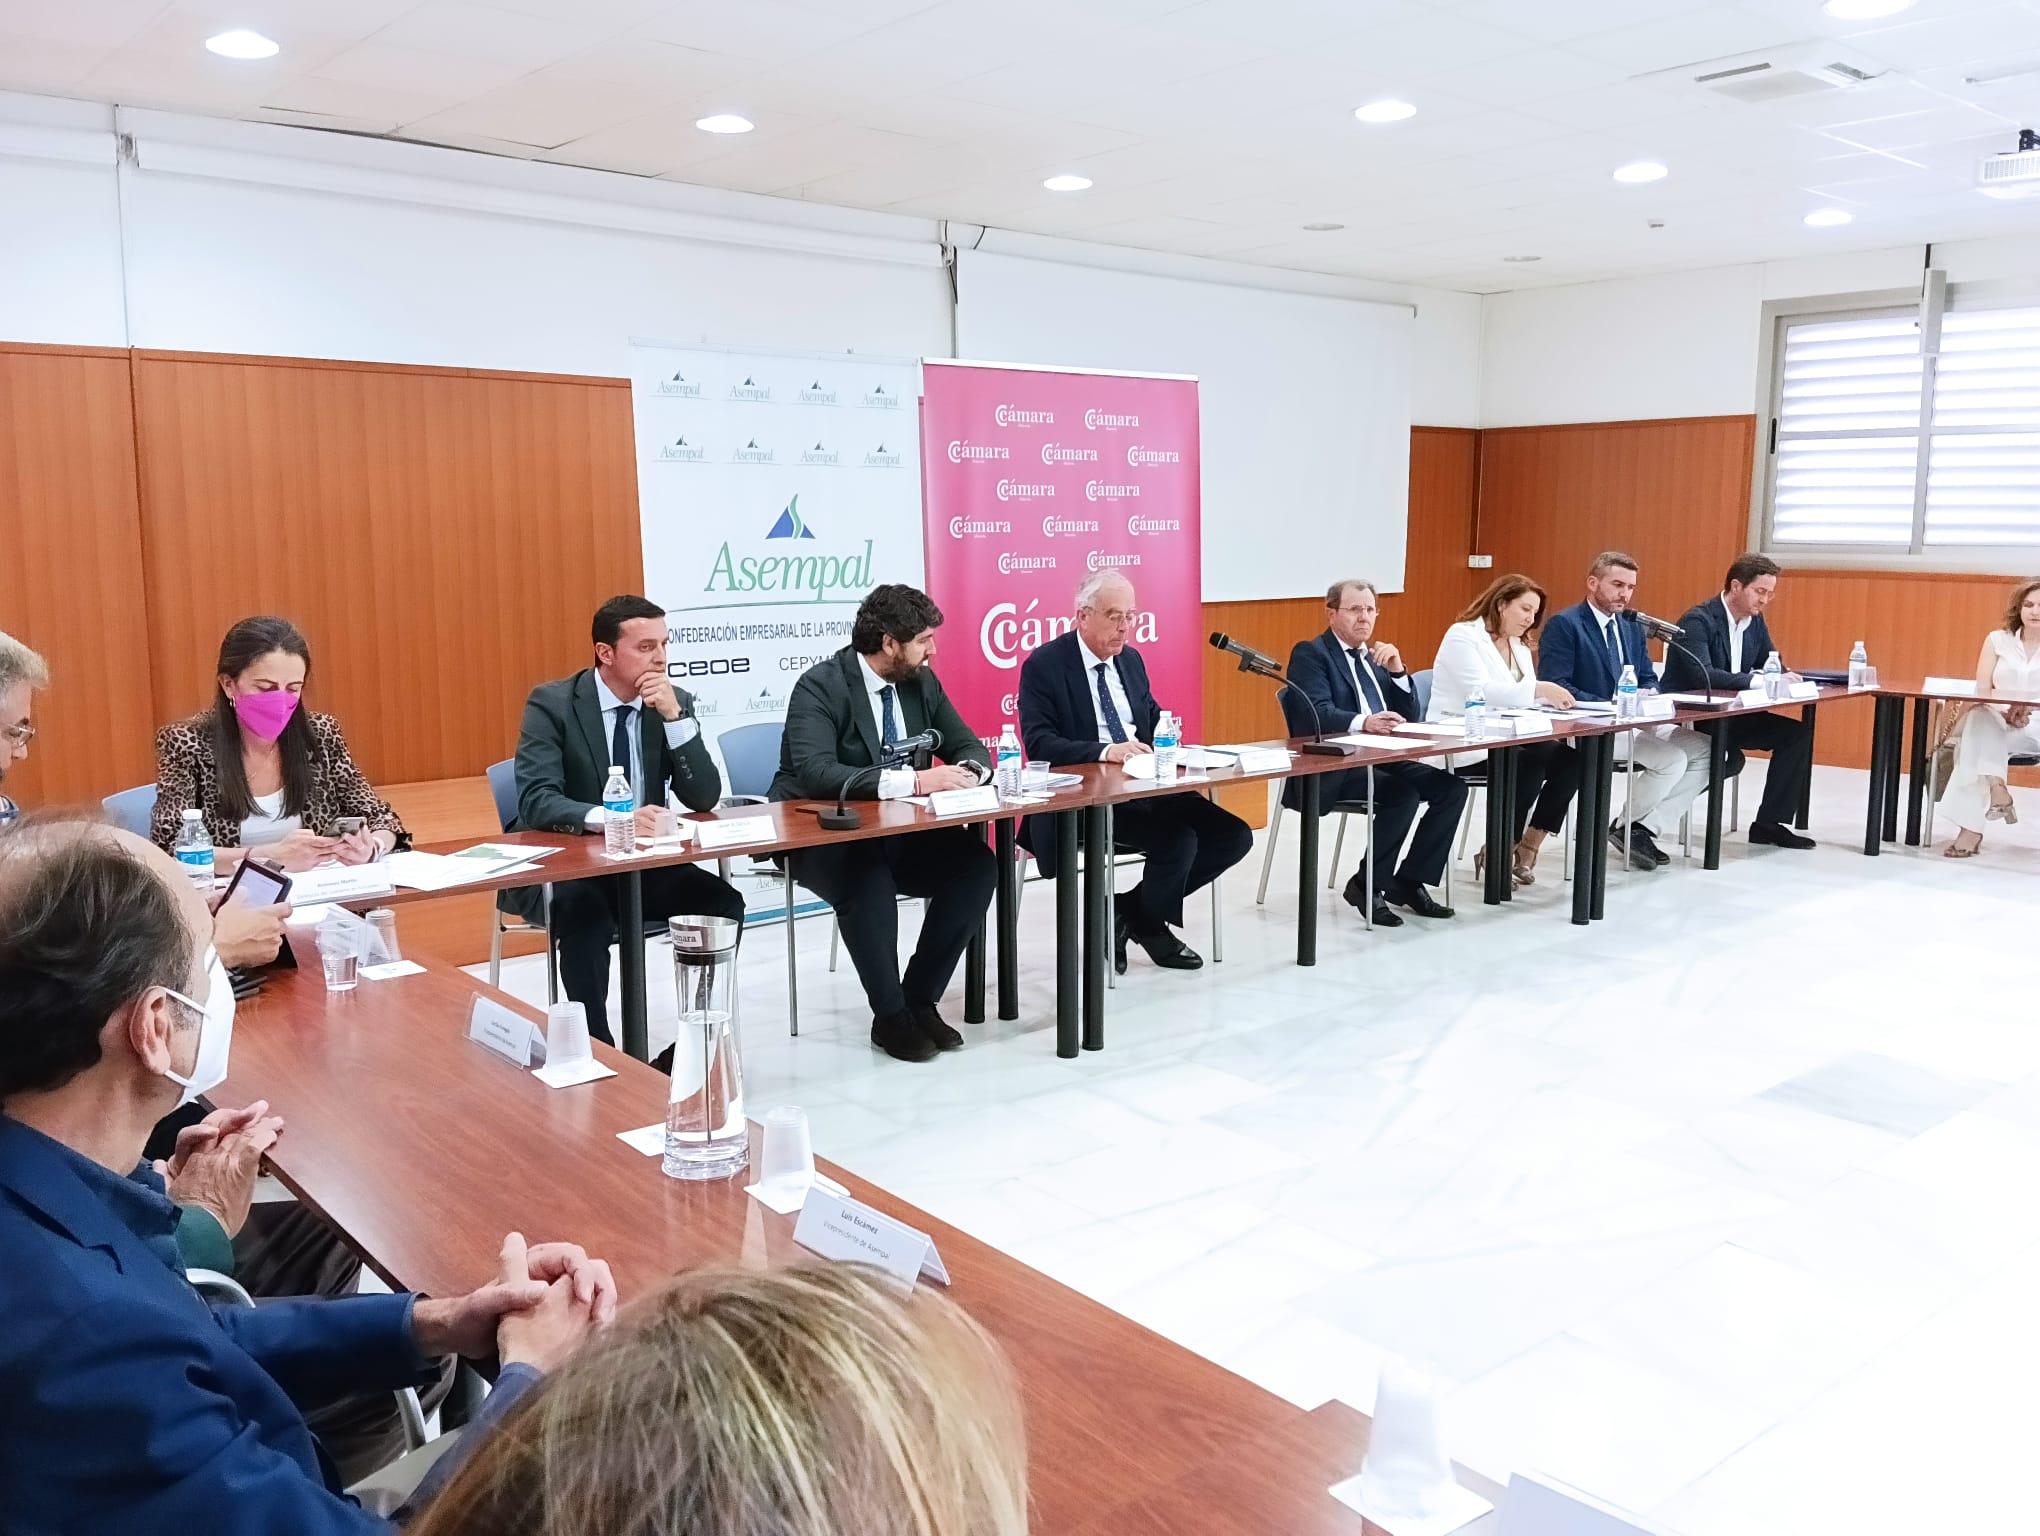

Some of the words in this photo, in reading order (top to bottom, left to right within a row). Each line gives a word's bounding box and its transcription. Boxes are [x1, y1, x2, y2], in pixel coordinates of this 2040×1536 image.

[657, 381, 701, 398] Asempal
[729, 385, 771, 402] Asempal
[798, 389, 836, 405] Asempal
[862, 393, 898, 409] Asempal
[660, 445, 704, 462] Asempal
[732, 447, 774, 464] Asempal
[800, 449, 839, 466] Asempal
[864, 451, 901, 467] Asempal
[704, 539, 875, 602] Asempal
[667, 622, 738, 643] ONFEDERACIÓN
[740, 622, 799, 641] EMPRESARIAL
[800, 621, 812, 638] DE
[813, 621, 825, 637] LA
[826, 620, 856, 636] PROVIN
[746, 695, 786, 712] Asempal
